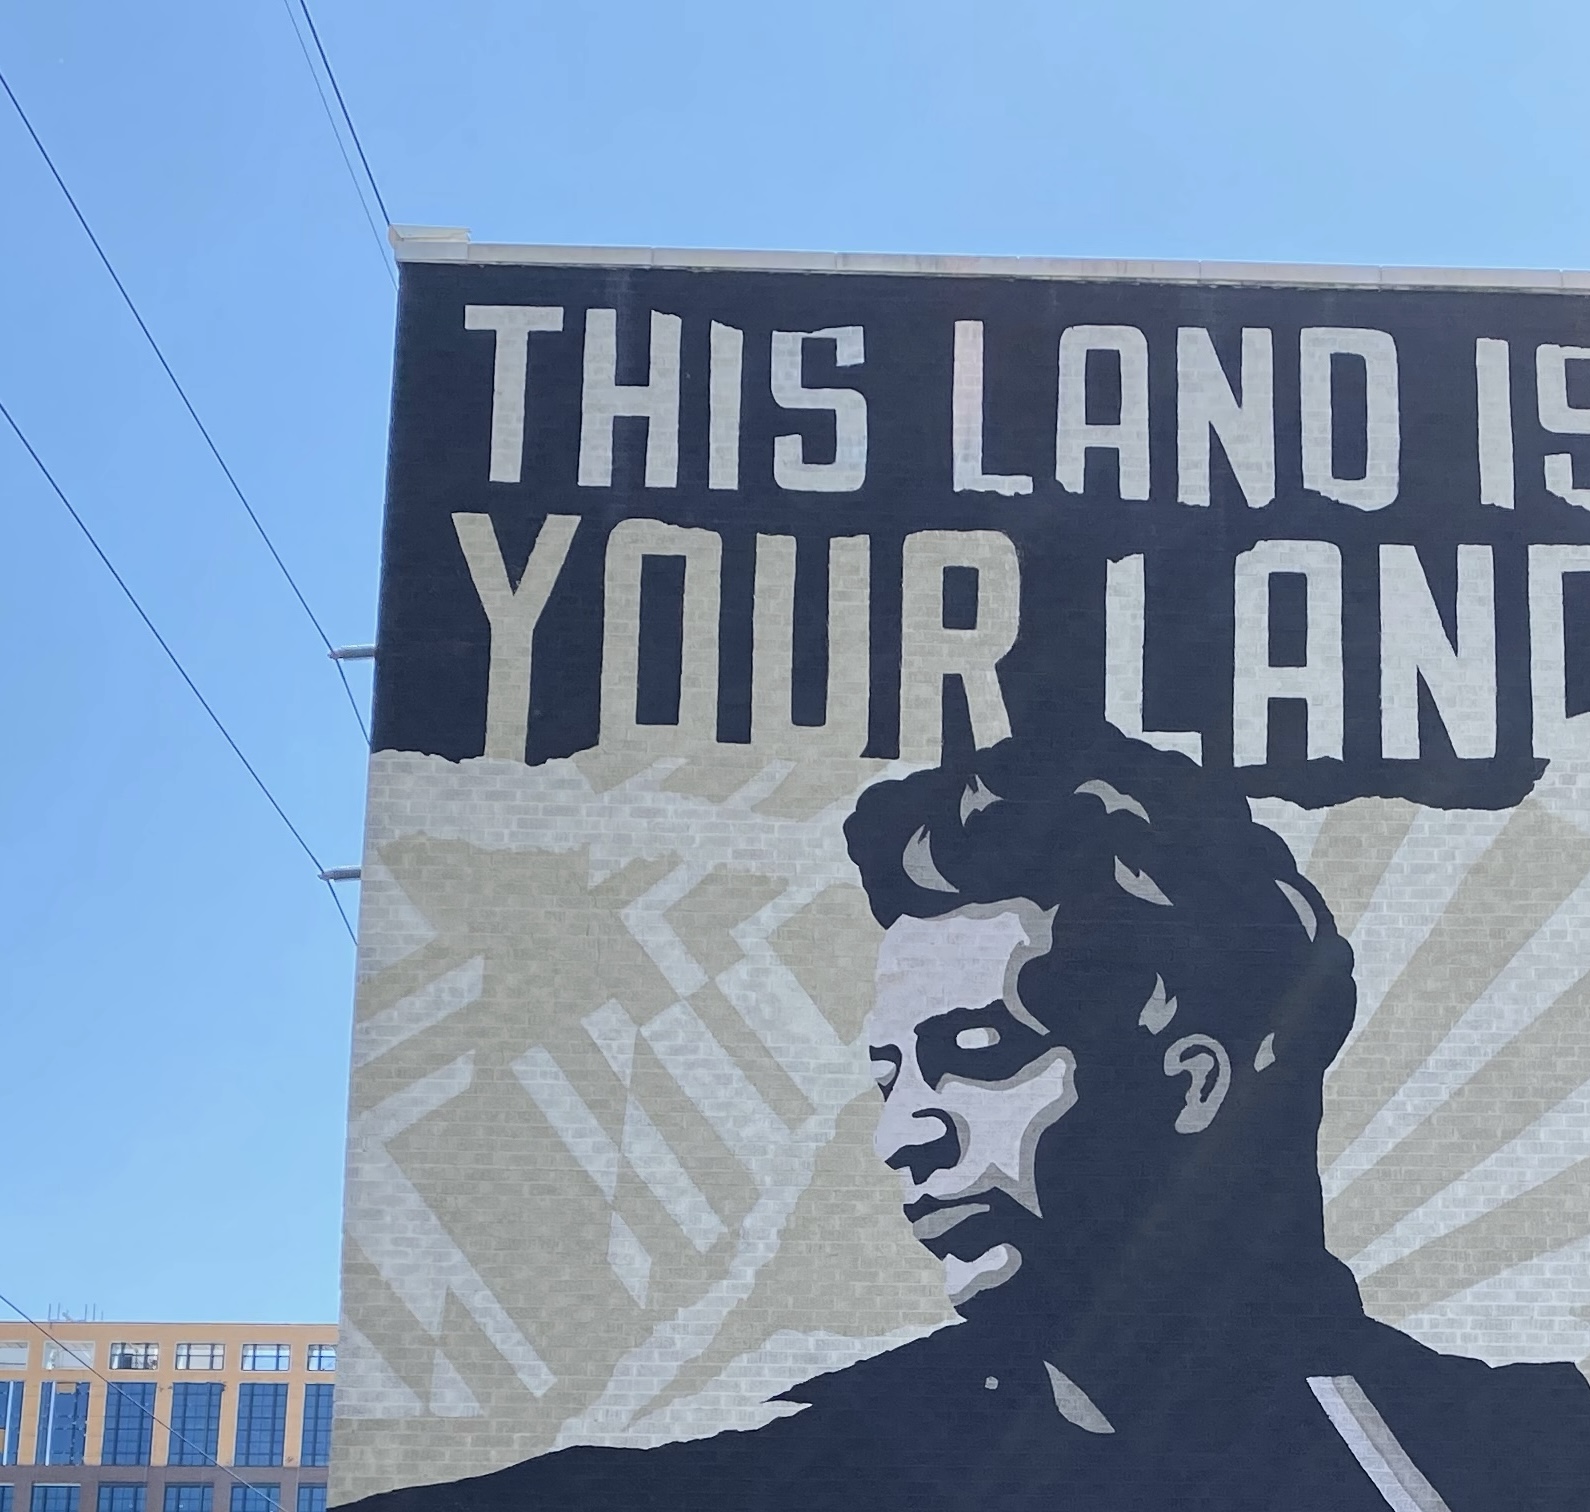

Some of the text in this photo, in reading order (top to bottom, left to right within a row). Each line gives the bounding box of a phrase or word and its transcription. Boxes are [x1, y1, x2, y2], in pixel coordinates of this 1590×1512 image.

[463, 305, 868, 493] THIS
[951, 319, 1400, 511] LAND
[450, 512, 1021, 766] YOUR
